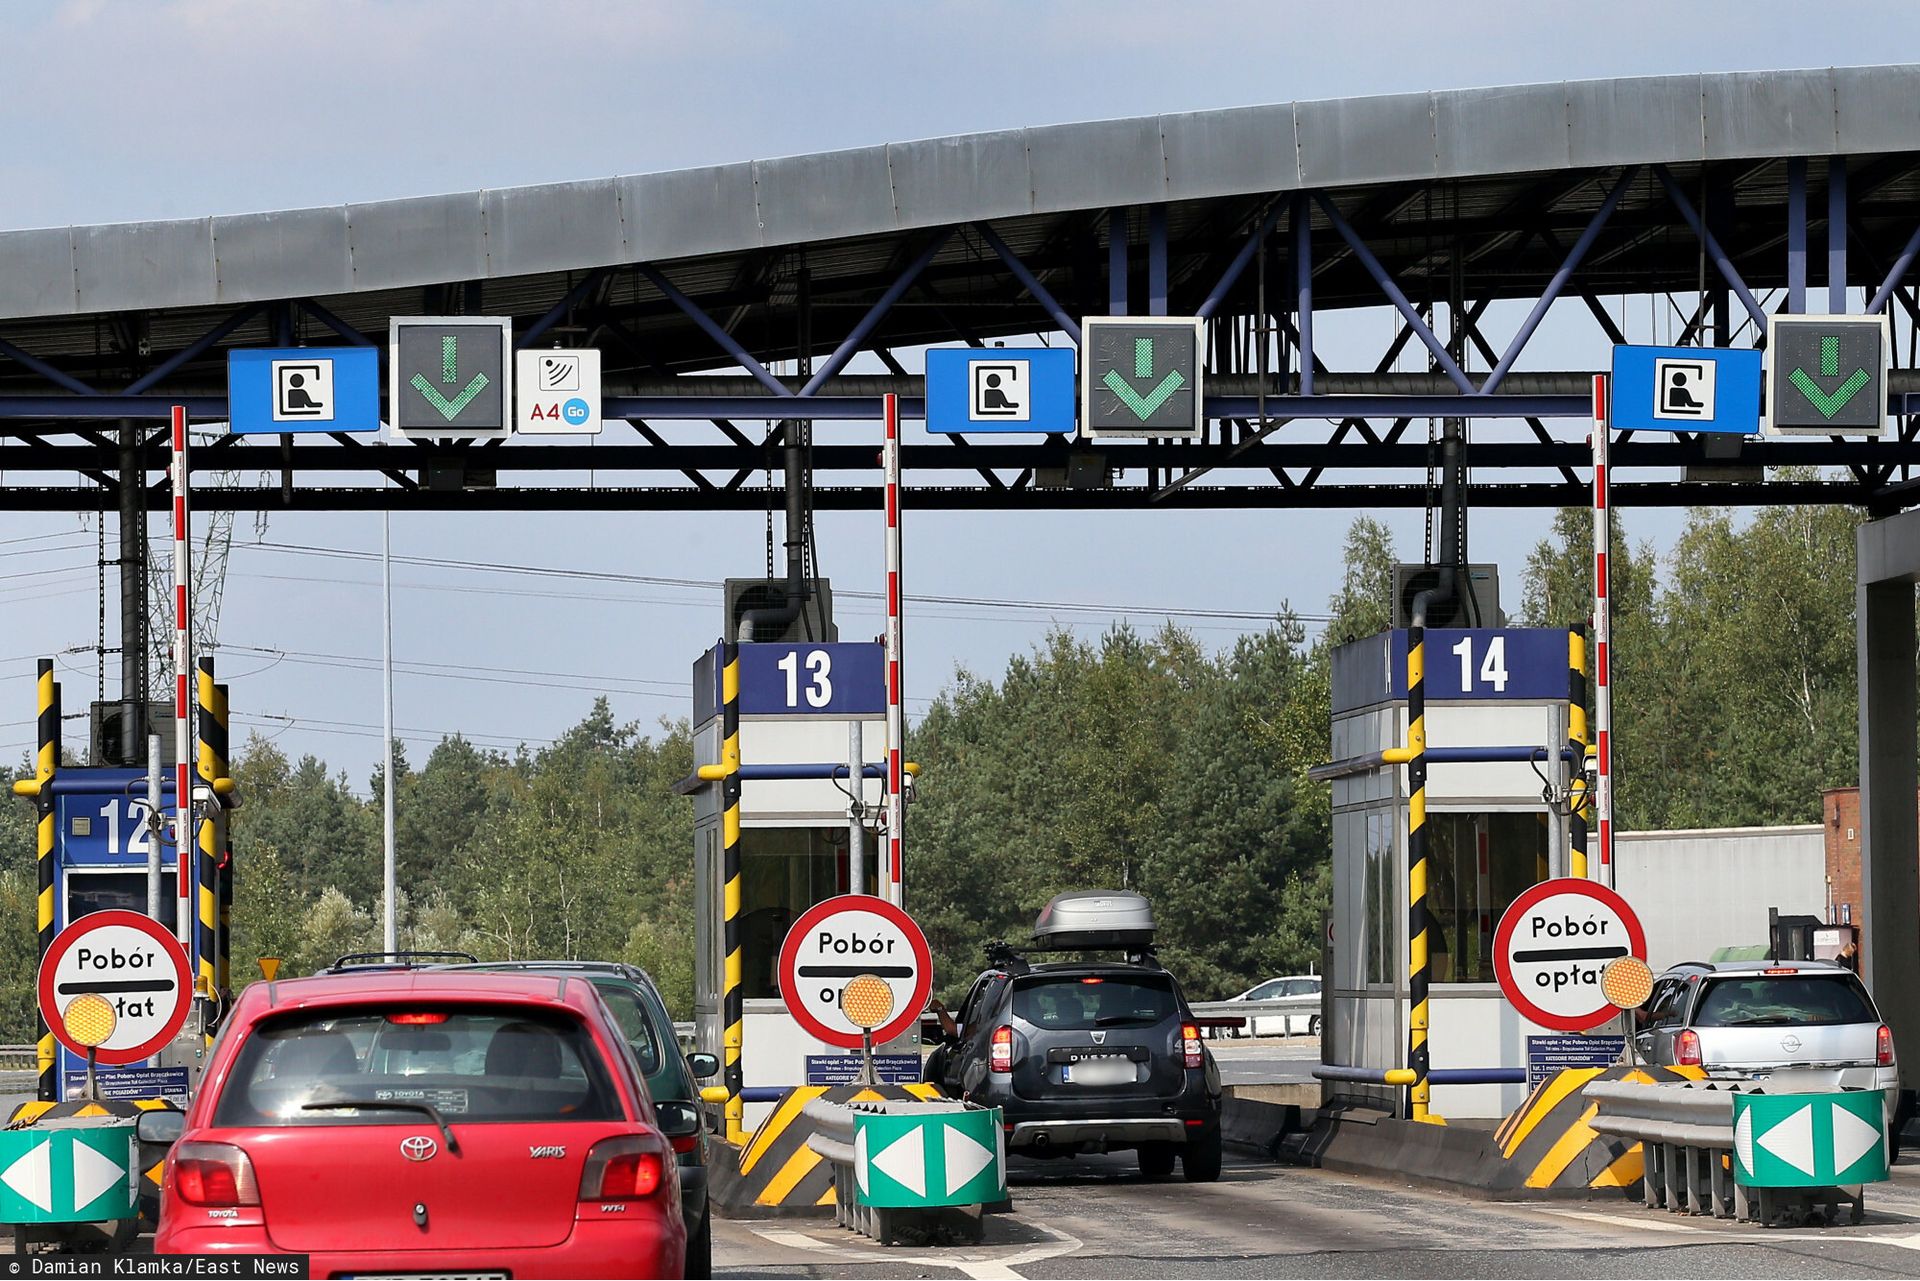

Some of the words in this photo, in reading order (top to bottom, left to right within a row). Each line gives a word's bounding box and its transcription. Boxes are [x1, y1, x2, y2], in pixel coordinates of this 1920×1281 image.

[530, 403, 560, 420] A4
[567, 406, 585, 417] Go
[1453, 636, 1508, 692] 14
[778, 650, 833, 708] 13
[100, 798, 150, 853] 12
[1532, 914, 1608, 938] Pobór
[819, 932, 895, 954] Pobór
[78, 947, 155, 970] Pobór
[115, 996, 155, 1019] łat
[529, 1145, 567, 1158] YARIS
[208, 1209, 239, 1218] TOYOTA
